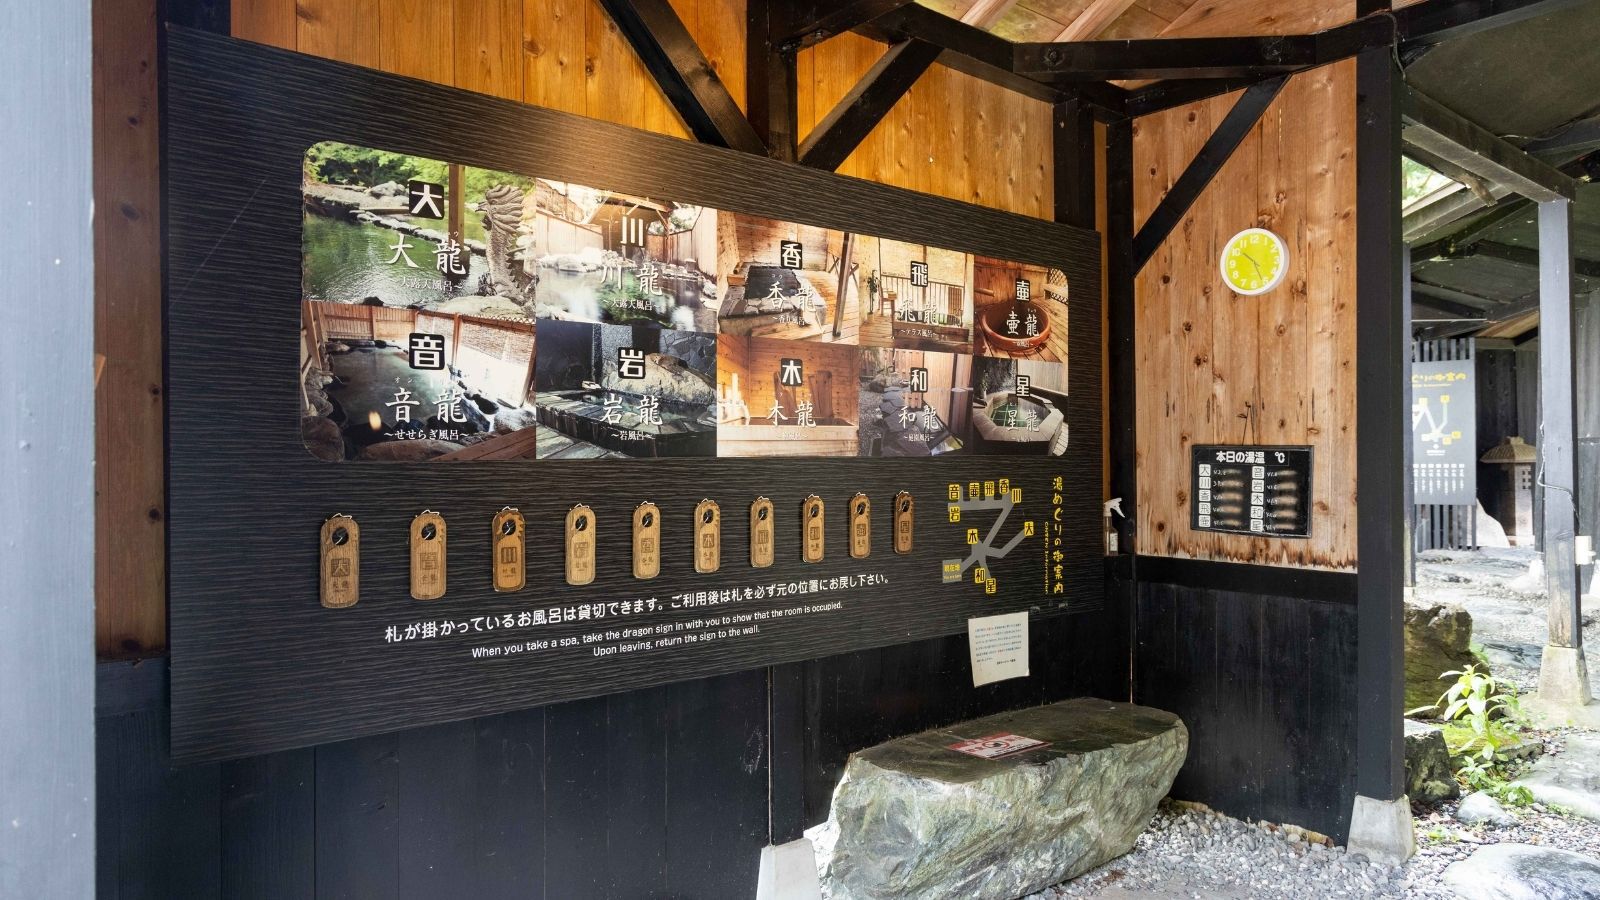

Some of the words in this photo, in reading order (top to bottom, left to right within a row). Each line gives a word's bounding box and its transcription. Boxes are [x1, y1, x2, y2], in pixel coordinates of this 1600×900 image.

[411, 184, 442, 218] 大
[622, 216, 644, 246] 川
[782, 243, 802, 268] 香
[412, 336, 442, 368] 音
[620, 349, 644, 377] 岩
[782, 360, 802, 384] 木
[911, 370, 927, 392] 和
[1016, 376, 1030, 396] 星
[385, 387, 467, 424] 音龍
[1216, 450, 1265, 464] 本日の湯温
[1200, 466, 1210, 475] 大
[1000, 480, 1009, 493] 香
[1200, 478, 1210, 488] 川
[950, 486, 960, 499] 音
[1252, 494, 1263, 504] 木
[950, 506, 960, 522] 岩
[1252, 507, 1263, 518] 和
[1025, 522, 1033, 535] 大
[968, 530, 977, 544] 木
[975, 568, 985, 583] 和
[986, 579, 996, 593] 星
[472, 646, 501, 658] When
[504, 644, 523, 655] you
[526, 640, 548, 651] take
[560, 637, 580, 647] spa,
[582, 633, 603, 643] take
[605, 631, 620, 640] the
[622, 626, 653, 638] dragon
[656, 623, 673, 634] sign
[676, 622, 684, 631] in
[685, 619, 704, 629] with
[706, 617, 720, 628] you
[732, 612, 752, 622] show
[754, 610, 770, 620] that
[771, 608, 783, 618] the
[784, 607, 803, 616] room
[804, 605, 811, 613] is
[812, 601, 843, 612] occupied.
[593, 646, 617, 657] Upon
[620, 640, 653, 653] leaving,
[655, 637, 682, 647] return
[684, 634, 698, 643] the
[700, 631, 716, 641] sign
[718, 630, 727, 638] to
[728, 627, 741, 636] the
[743, 624, 760, 635] wall.
